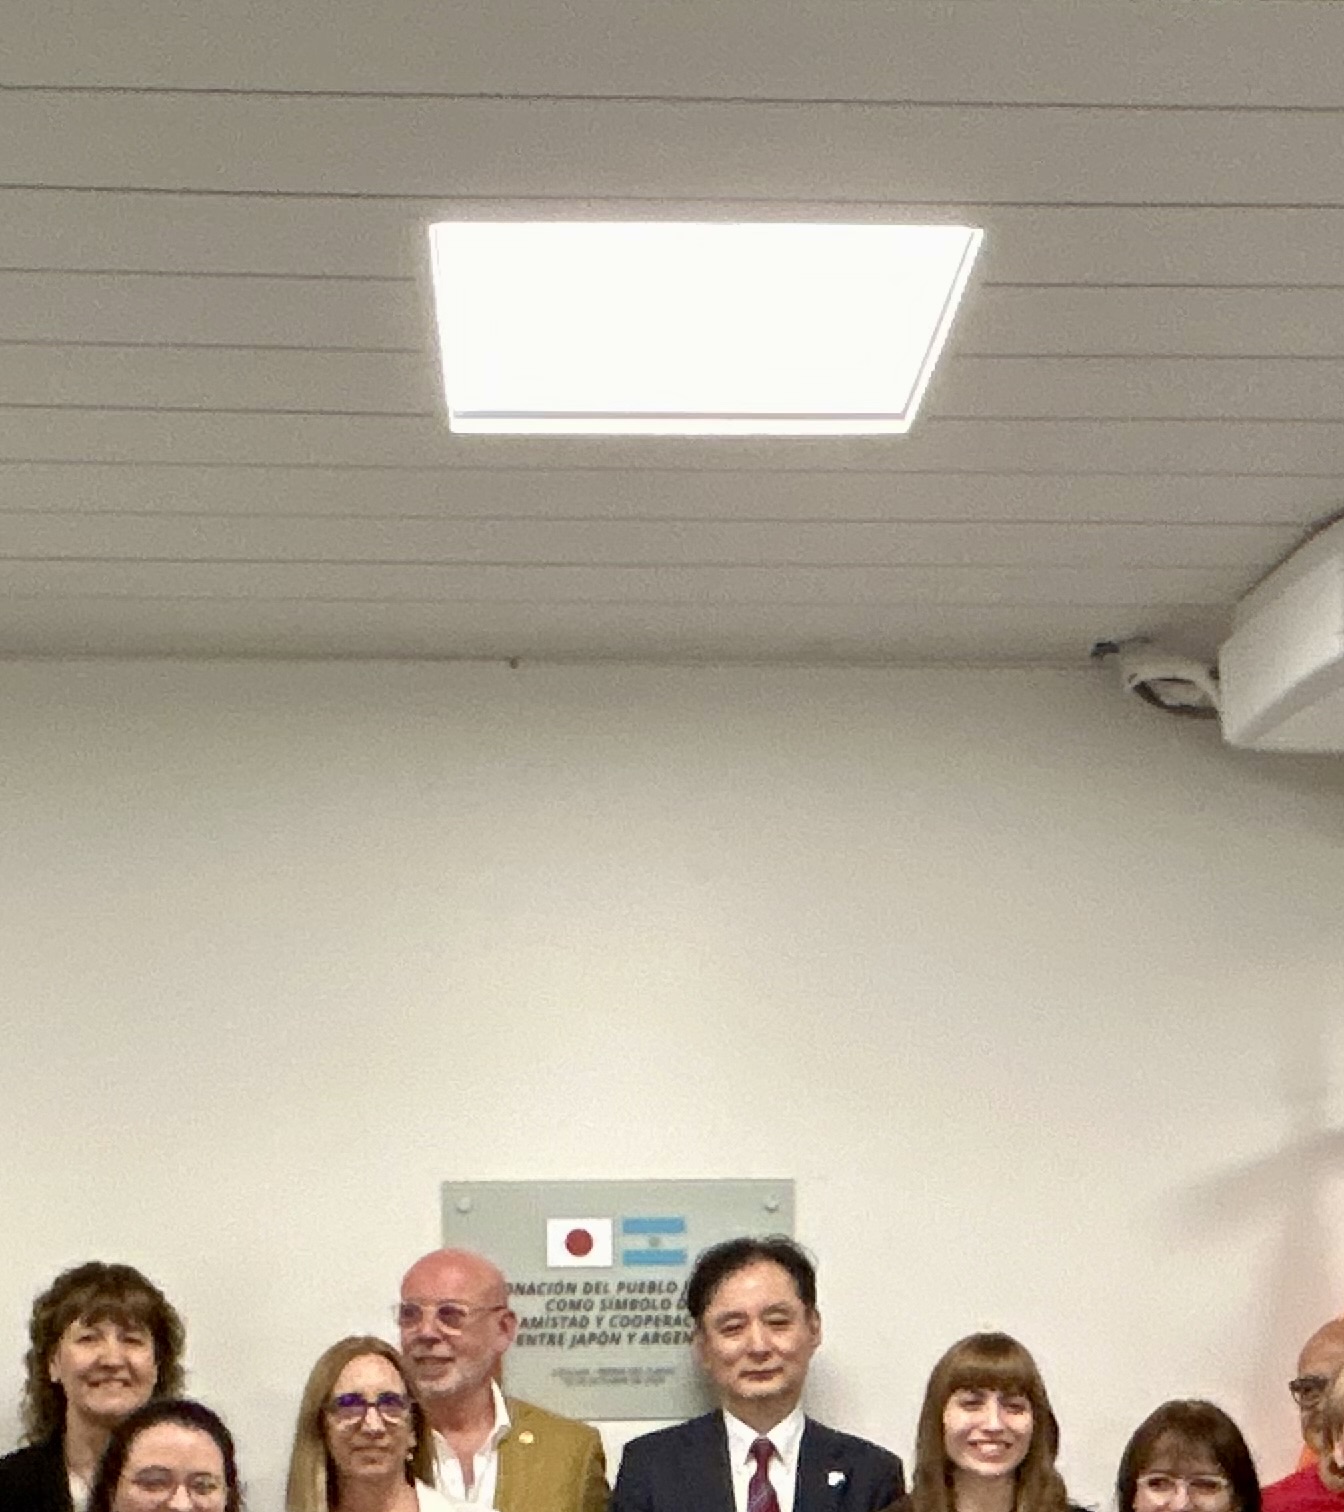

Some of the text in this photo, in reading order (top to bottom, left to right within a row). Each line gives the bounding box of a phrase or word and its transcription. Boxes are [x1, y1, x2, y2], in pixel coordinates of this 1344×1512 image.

[505, 1280, 577, 1295] ONACIÓN
[583, 1281, 609, 1295] DEL
[616, 1280, 678, 1295] PUEBLO
[545, 1298, 594, 1311] COMO
[596, 1315, 604, 1328] Y
[608, 1314, 693, 1328] COOPERAC
[516, 1330, 694, 1348] ENTRE JAPÓN Y ARGEN
